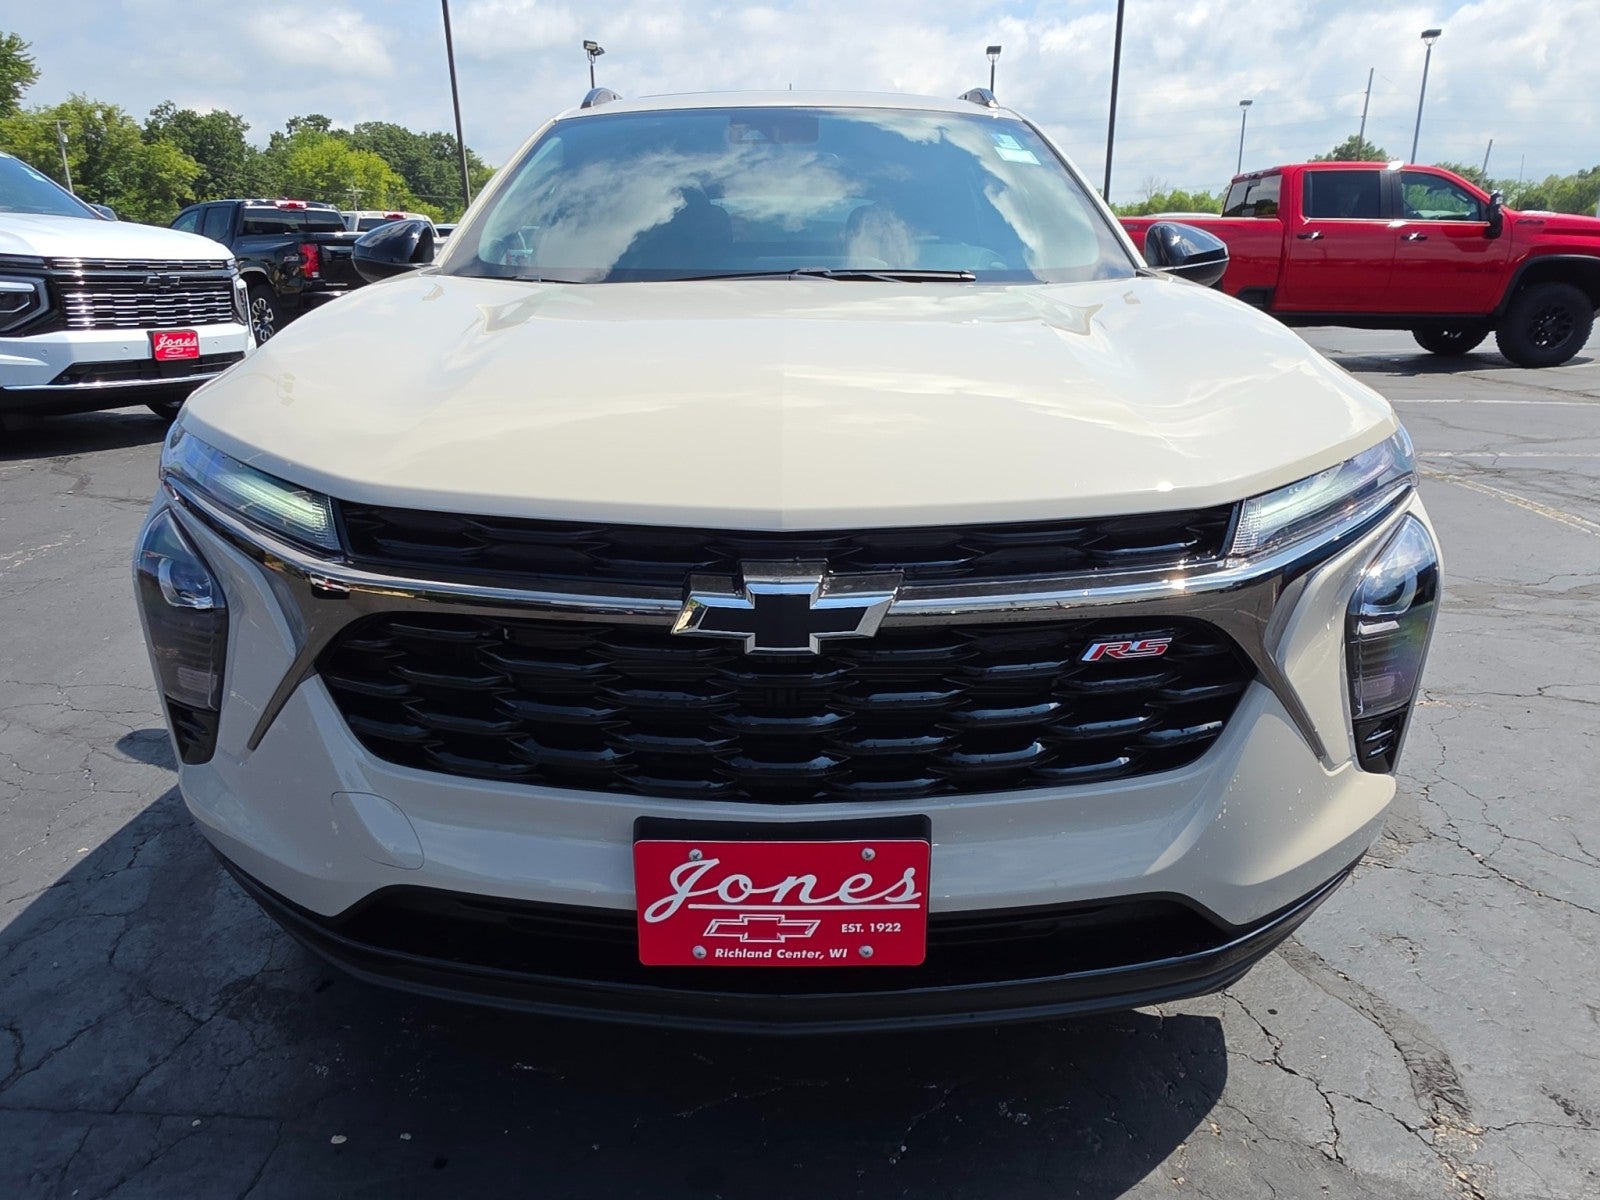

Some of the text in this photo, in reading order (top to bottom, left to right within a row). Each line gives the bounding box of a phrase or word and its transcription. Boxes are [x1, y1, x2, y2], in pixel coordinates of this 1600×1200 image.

[155, 336, 198, 351] Jones
[1081, 638, 1172, 661] RS
[644, 858, 921, 923] Jones
[841, 922, 901, 933] EST. 1922
[715, 948, 847, 960] Richland Center, WI
